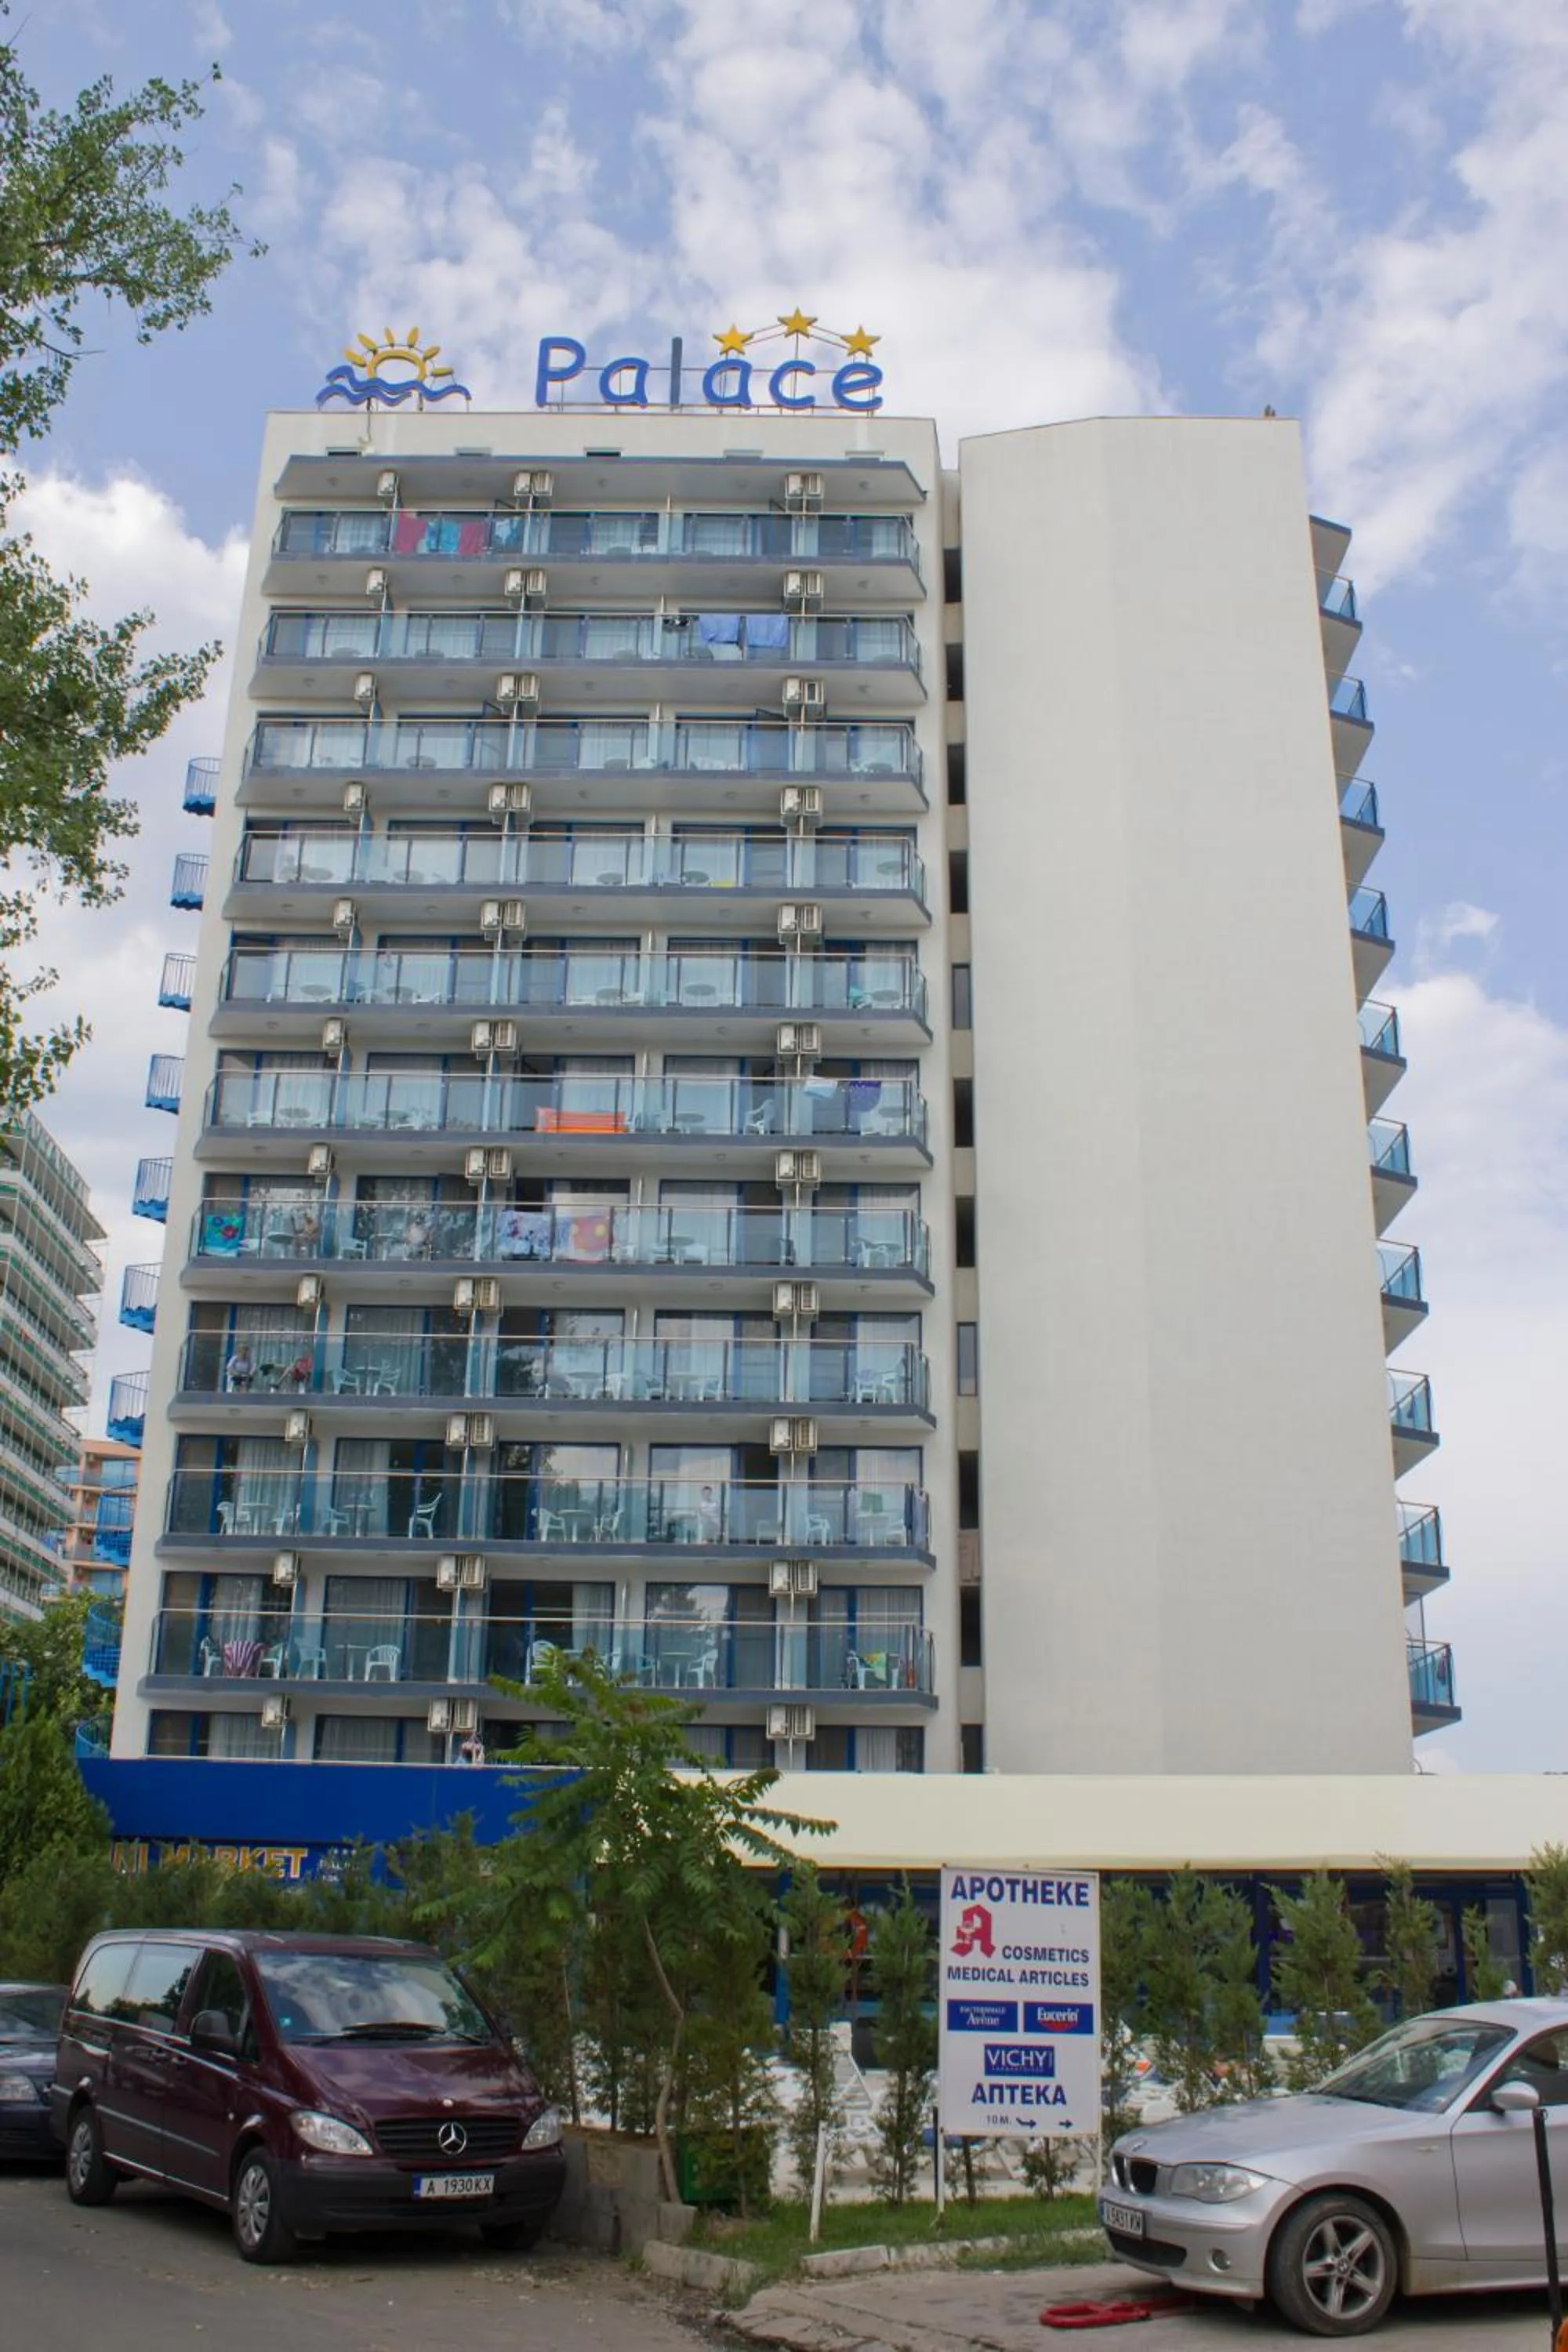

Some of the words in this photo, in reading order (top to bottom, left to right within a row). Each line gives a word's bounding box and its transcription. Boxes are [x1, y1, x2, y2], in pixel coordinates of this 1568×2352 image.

[535, 336, 884, 410] Palace
[951, 1875, 1089, 1907] APOTHEKE
[1002, 1945, 1090, 1963] COSMETICS
[947, 1966, 1014, 1984] MEDICAL
[1019, 1970, 1090, 1987] ARTICLES
[1037, 2007, 1078, 2022] Eucerin
[986, 2049, 1047, 2067] VICHY
[971, 2082, 1067, 2105] АПТЕКА
